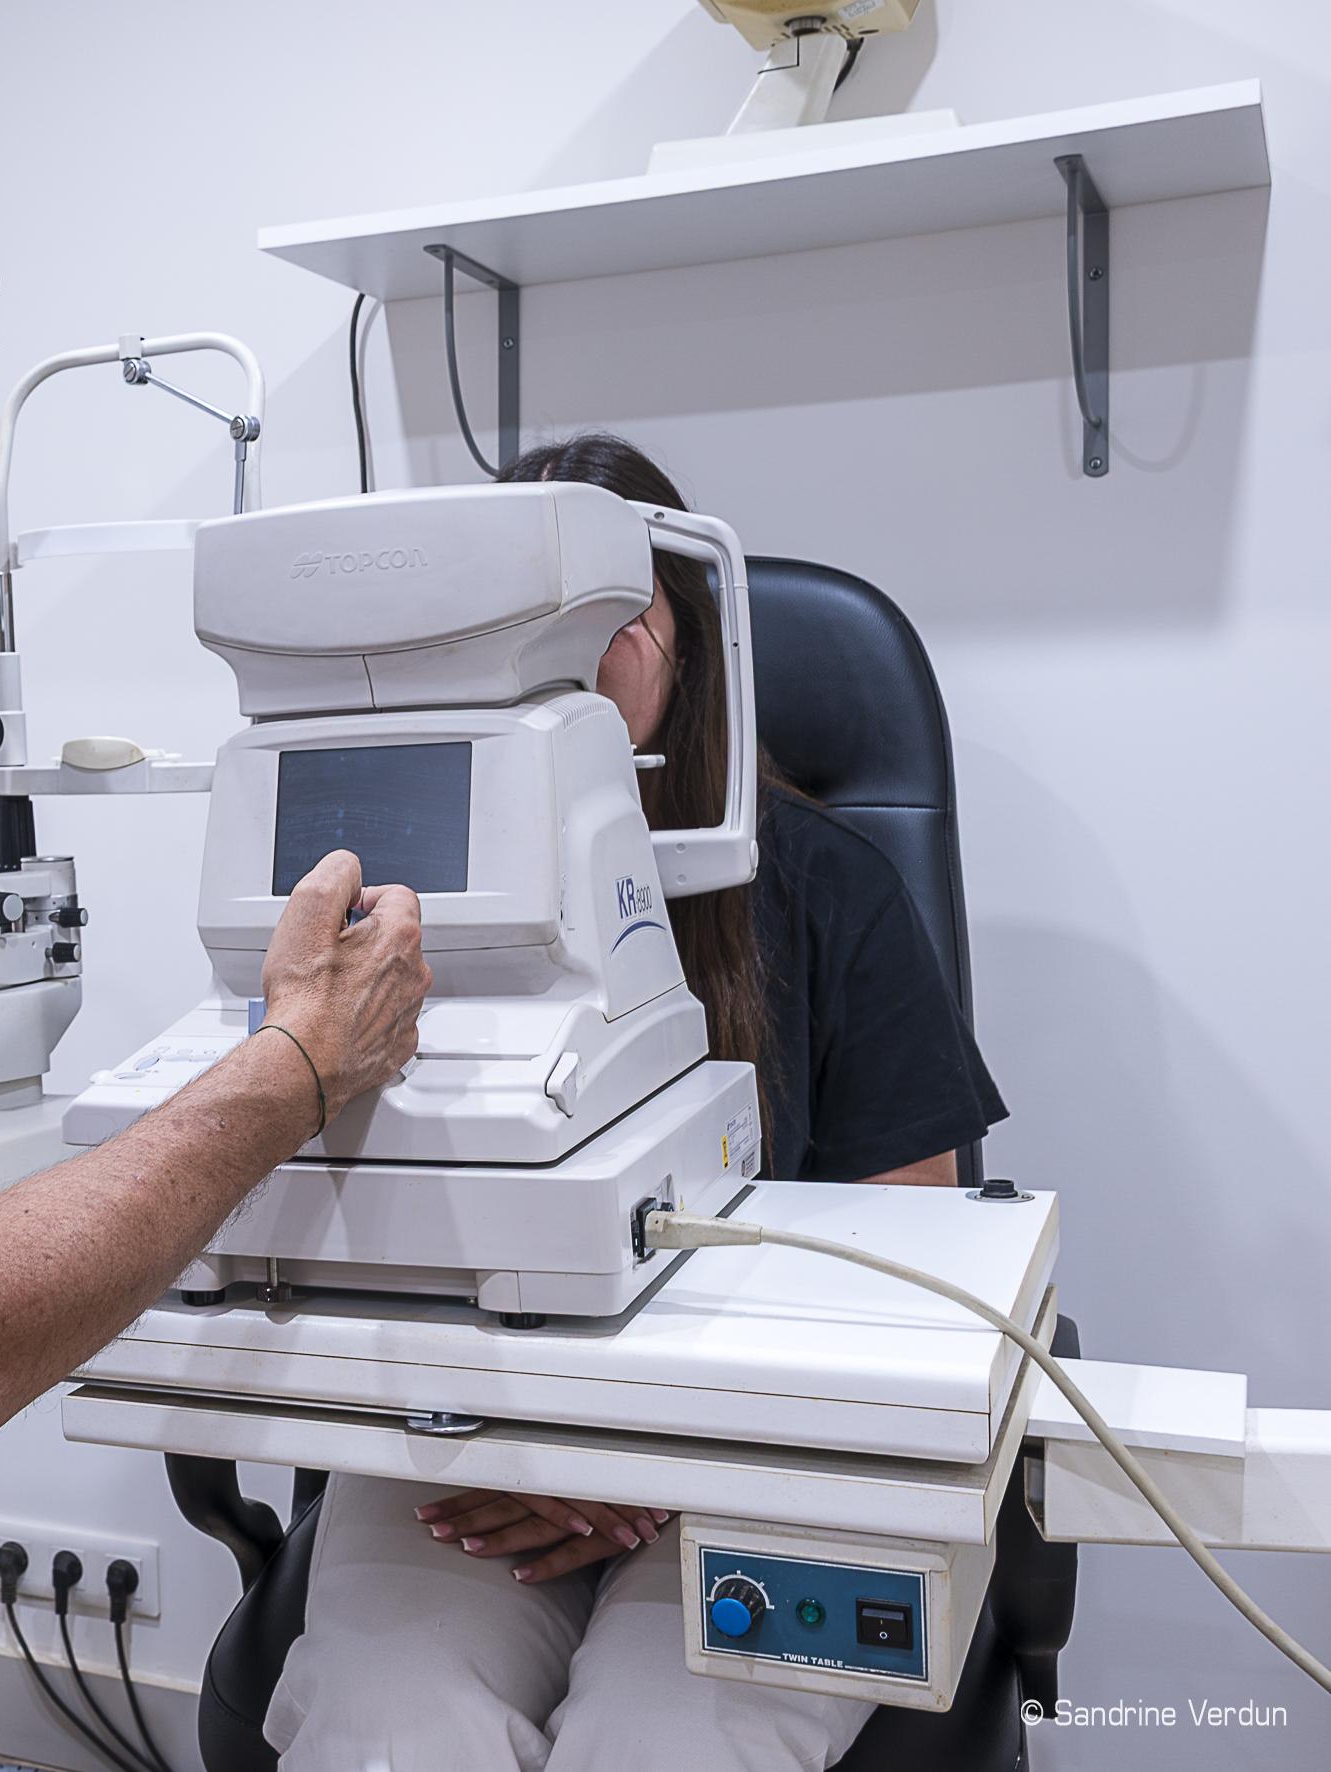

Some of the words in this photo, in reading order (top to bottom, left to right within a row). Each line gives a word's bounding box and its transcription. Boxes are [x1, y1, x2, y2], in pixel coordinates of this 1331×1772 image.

[324, 549, 428, 574] TOPCON
[782, 1652, 808, 1664] TWIN
[811, 1656, 844, 1669] TABLE
